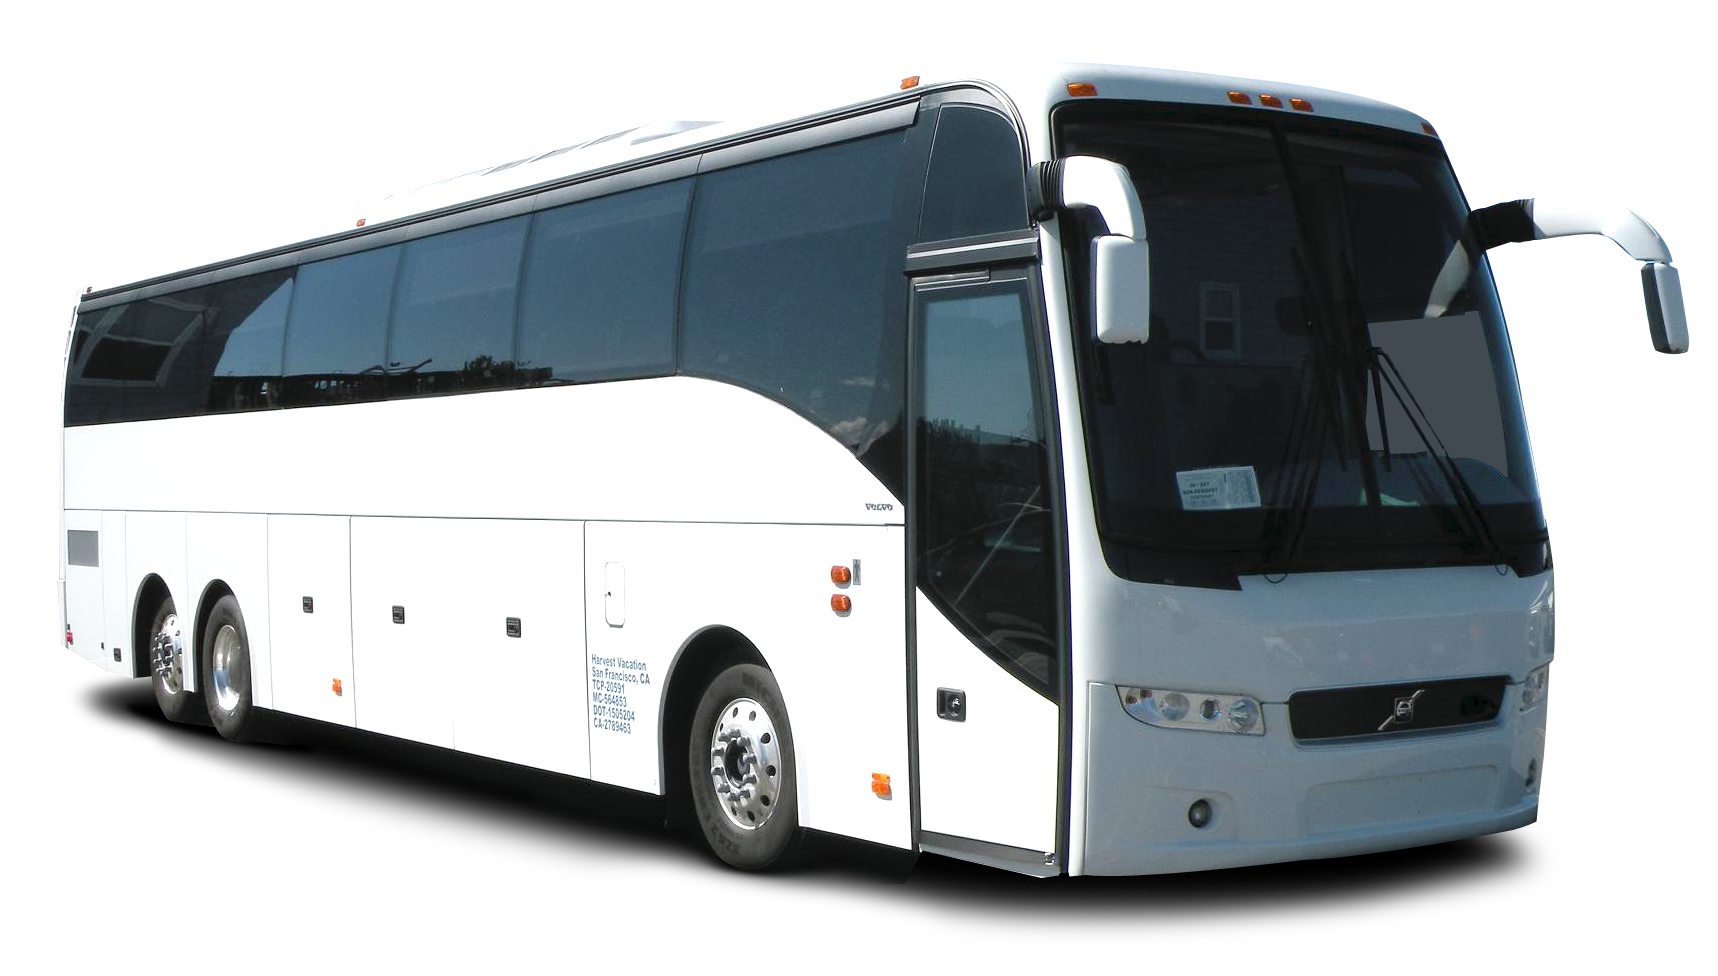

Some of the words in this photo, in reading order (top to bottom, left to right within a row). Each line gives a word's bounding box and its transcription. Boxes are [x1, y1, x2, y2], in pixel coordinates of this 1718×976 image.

[865, 503, 893, 511] VOLVO
[591, 653, 615, 667] Harvest
[617, 657, 646, 671] Vacation
[591, 666, 604, 678] San
[605, 668, 638, 685] Francisco,
[640, 672, 651, 685] CA
[592, 679, 625, 694] TCP-20591
